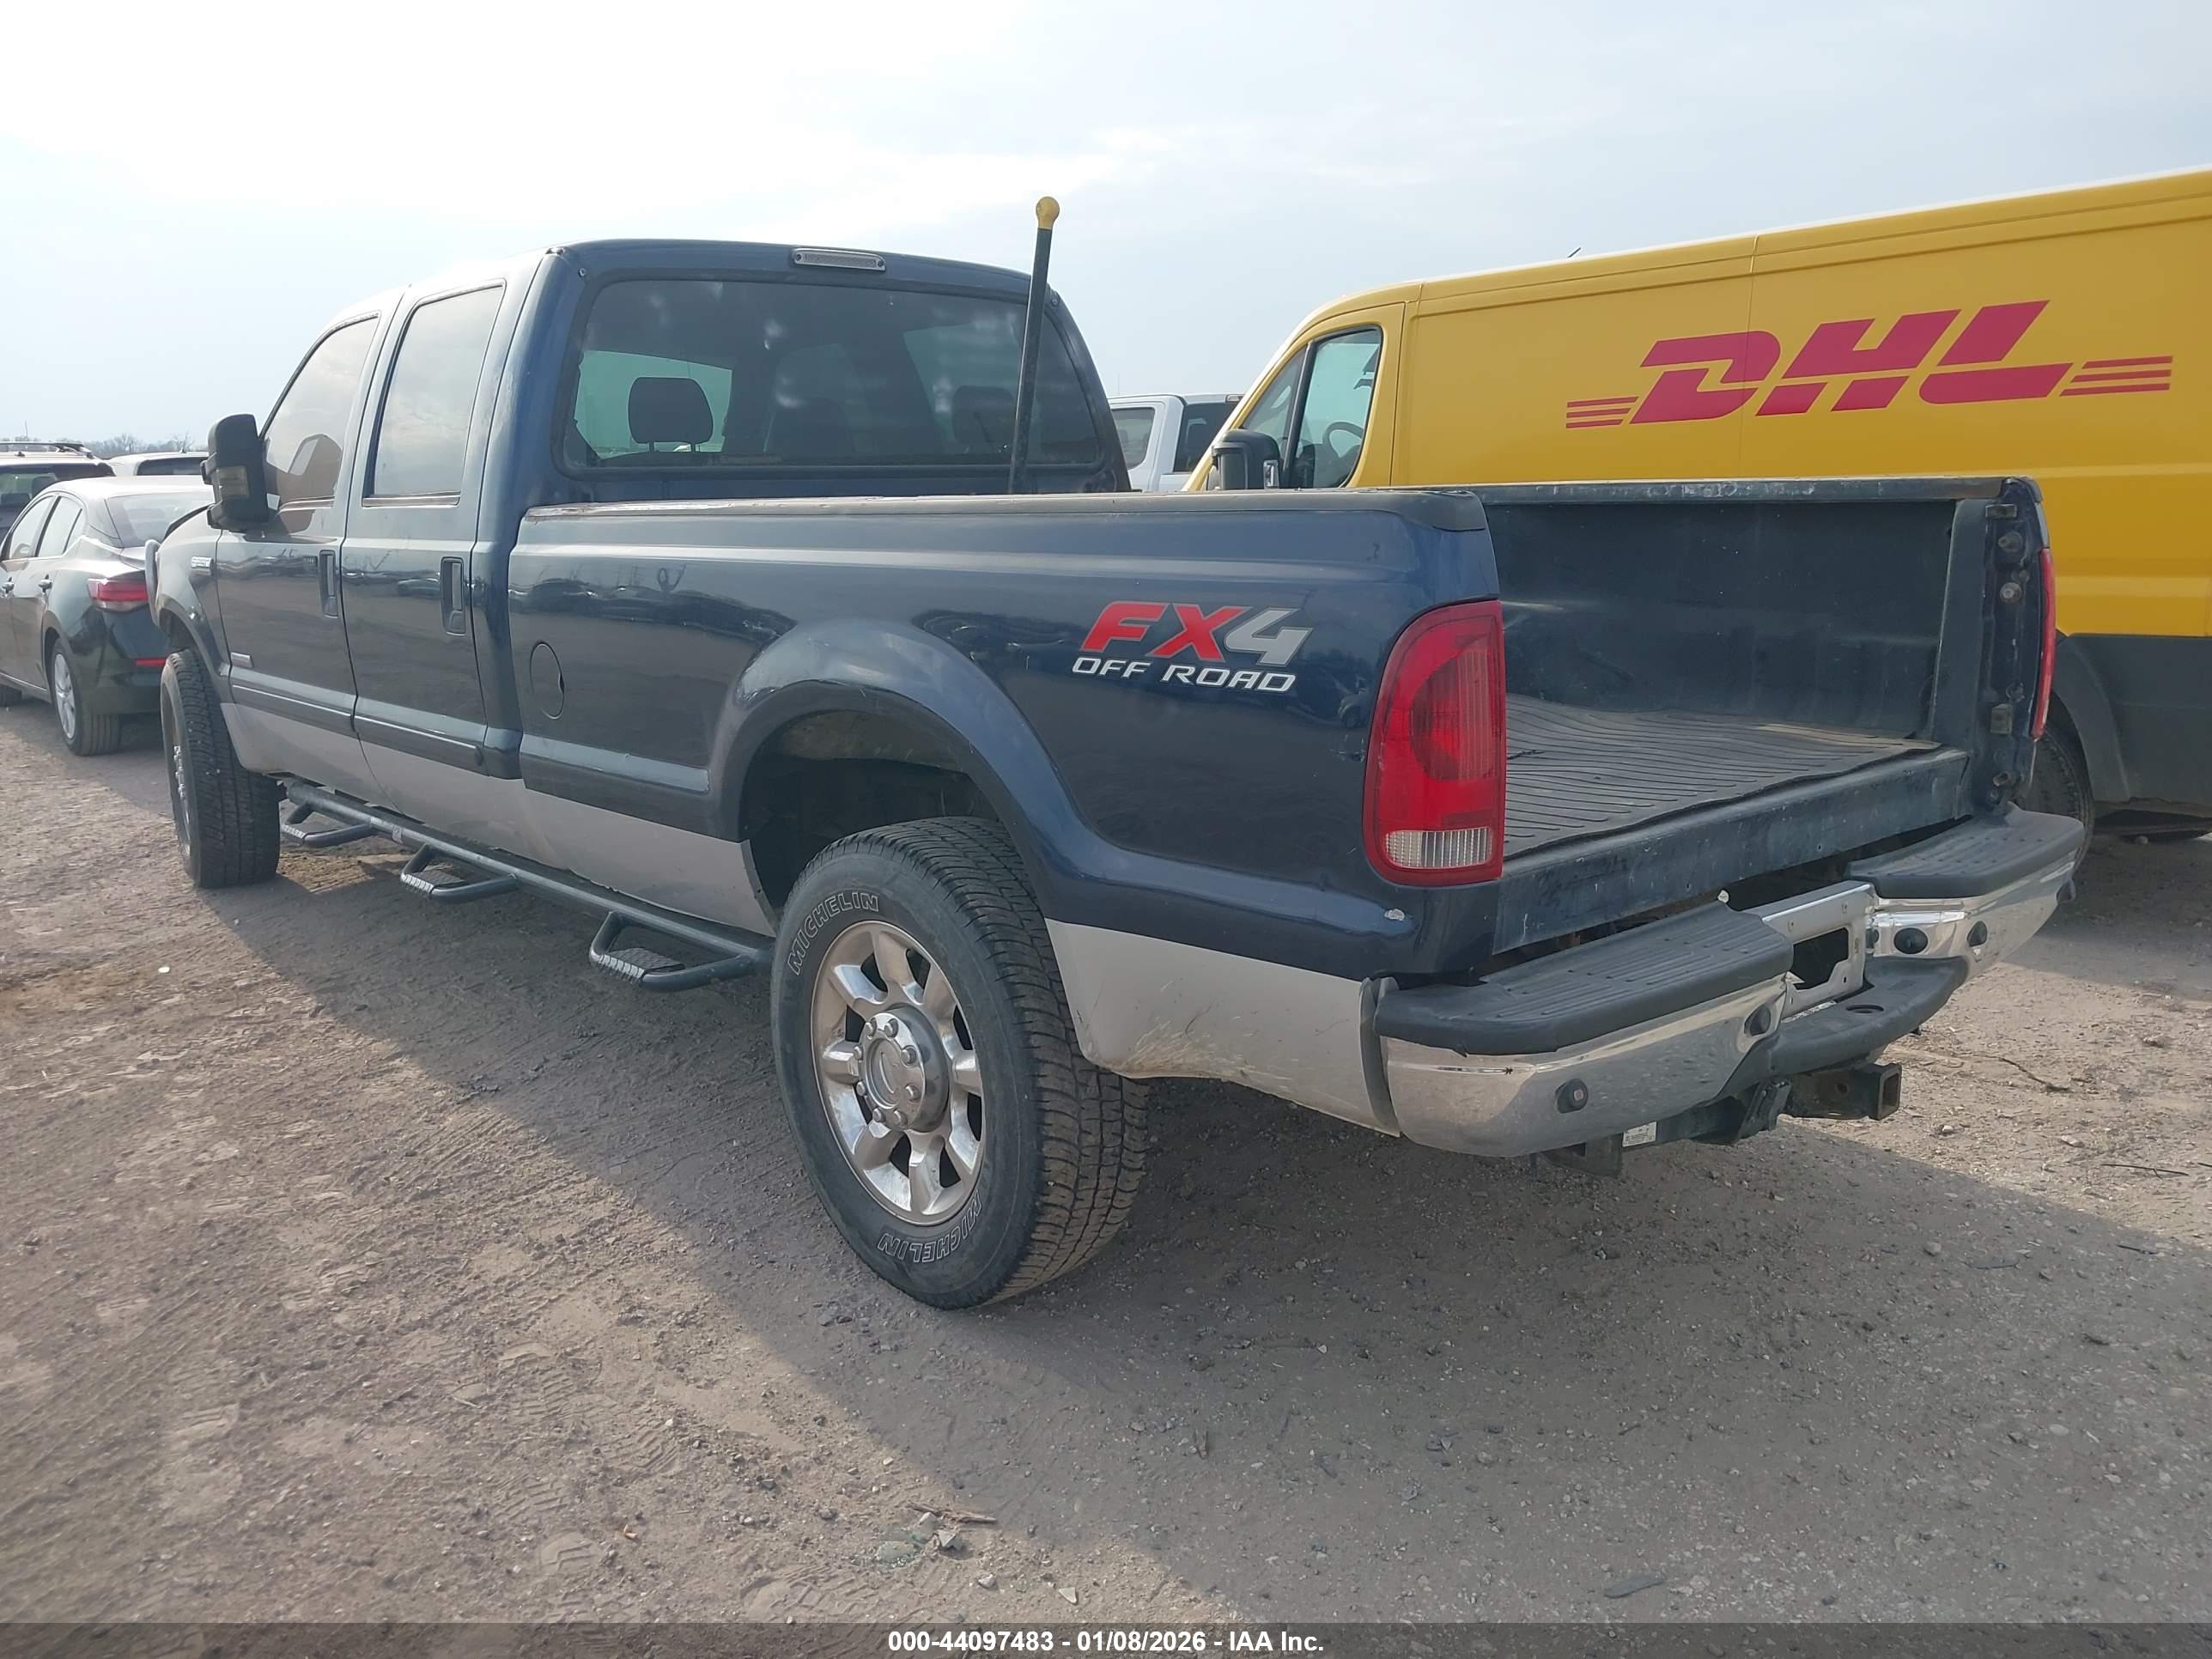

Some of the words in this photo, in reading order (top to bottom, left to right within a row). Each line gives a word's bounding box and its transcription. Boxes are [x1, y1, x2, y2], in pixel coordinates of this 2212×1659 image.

[1630, 300, 2072, 423] DHL
[1079, 602, 1312, 665] FX4
[1072, 657, 1151, 678] OFF
[1162, 665, 1296, 692] ROAD
[787, 891, 879, 975] MICHELIN
[878, 1188, 982, 1263] MICHELIN
